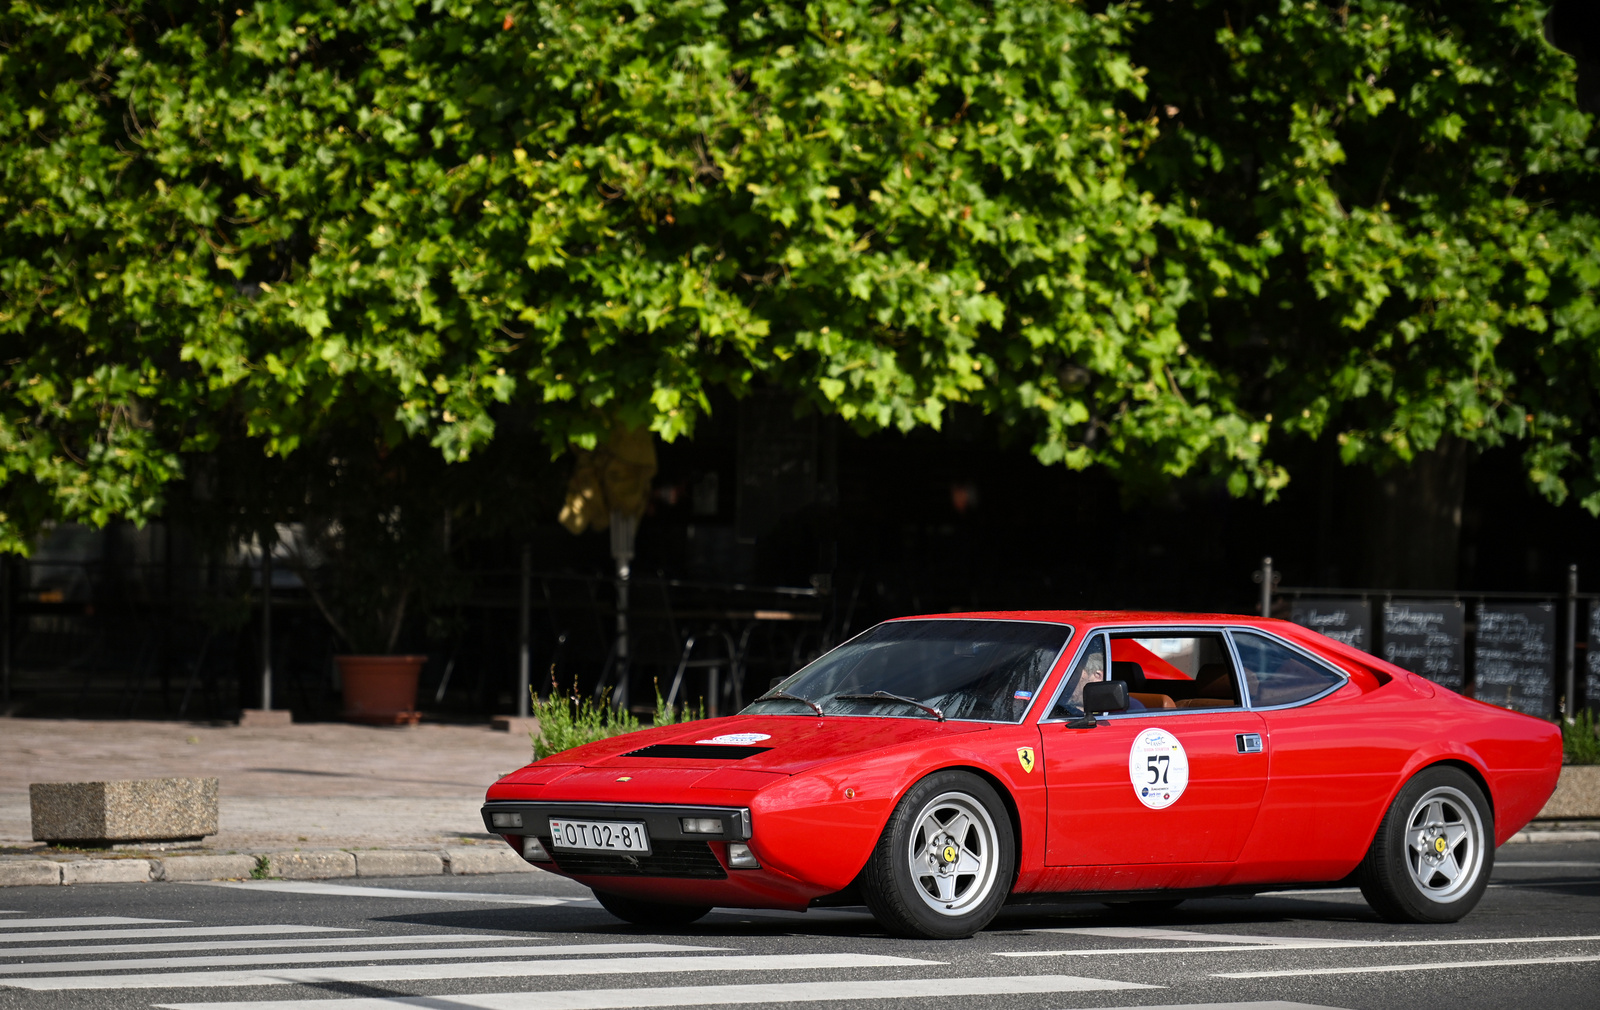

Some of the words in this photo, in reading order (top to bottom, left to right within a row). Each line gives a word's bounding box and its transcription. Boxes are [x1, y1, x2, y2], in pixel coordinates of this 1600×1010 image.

[1147, 754, 1170, 785] 57
[555, 834, 563, 845] H
[565, 823, 588, 846] OT
[592, 825, 643, 849] 02-81
